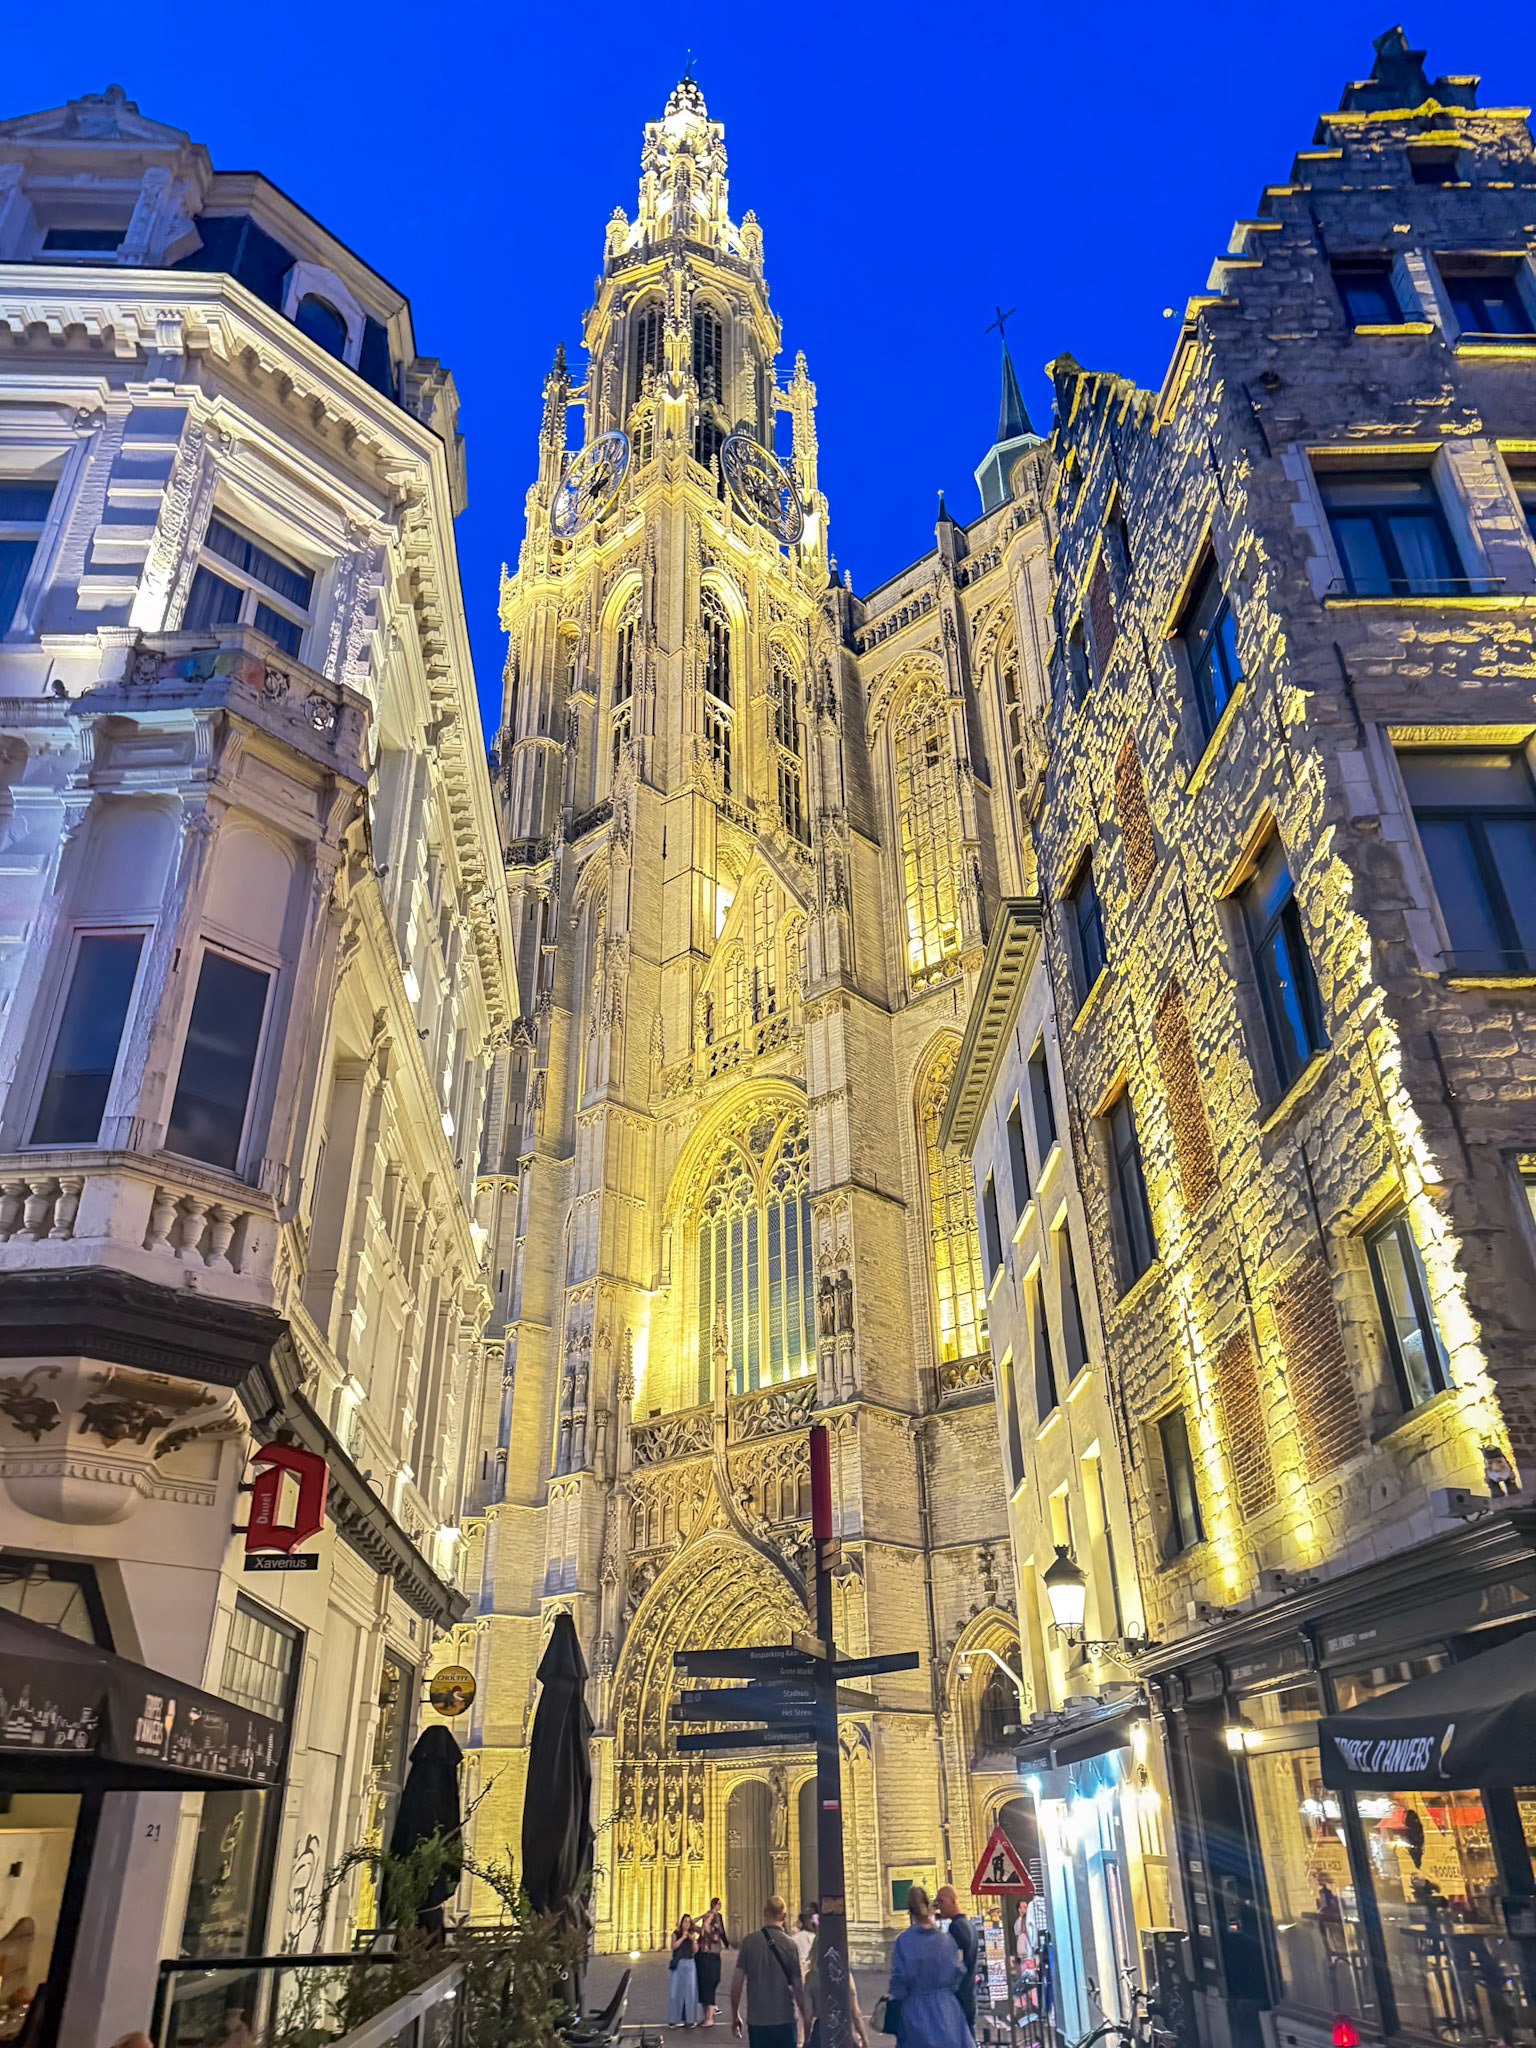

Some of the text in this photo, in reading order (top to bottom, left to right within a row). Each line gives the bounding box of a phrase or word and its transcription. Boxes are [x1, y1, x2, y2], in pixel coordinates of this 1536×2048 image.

[254, 1557, 307, 1568] Xaverius
[780, 1667, 814, 1675] Grote Markt
[783, 1689, 809, 1697] Stadhuis
[782, 1708, 812, 1716] Het Steen
[1371, 1736, 1435, 1773] D'ANVERS
[146, 1823, 161, 1838] 21
